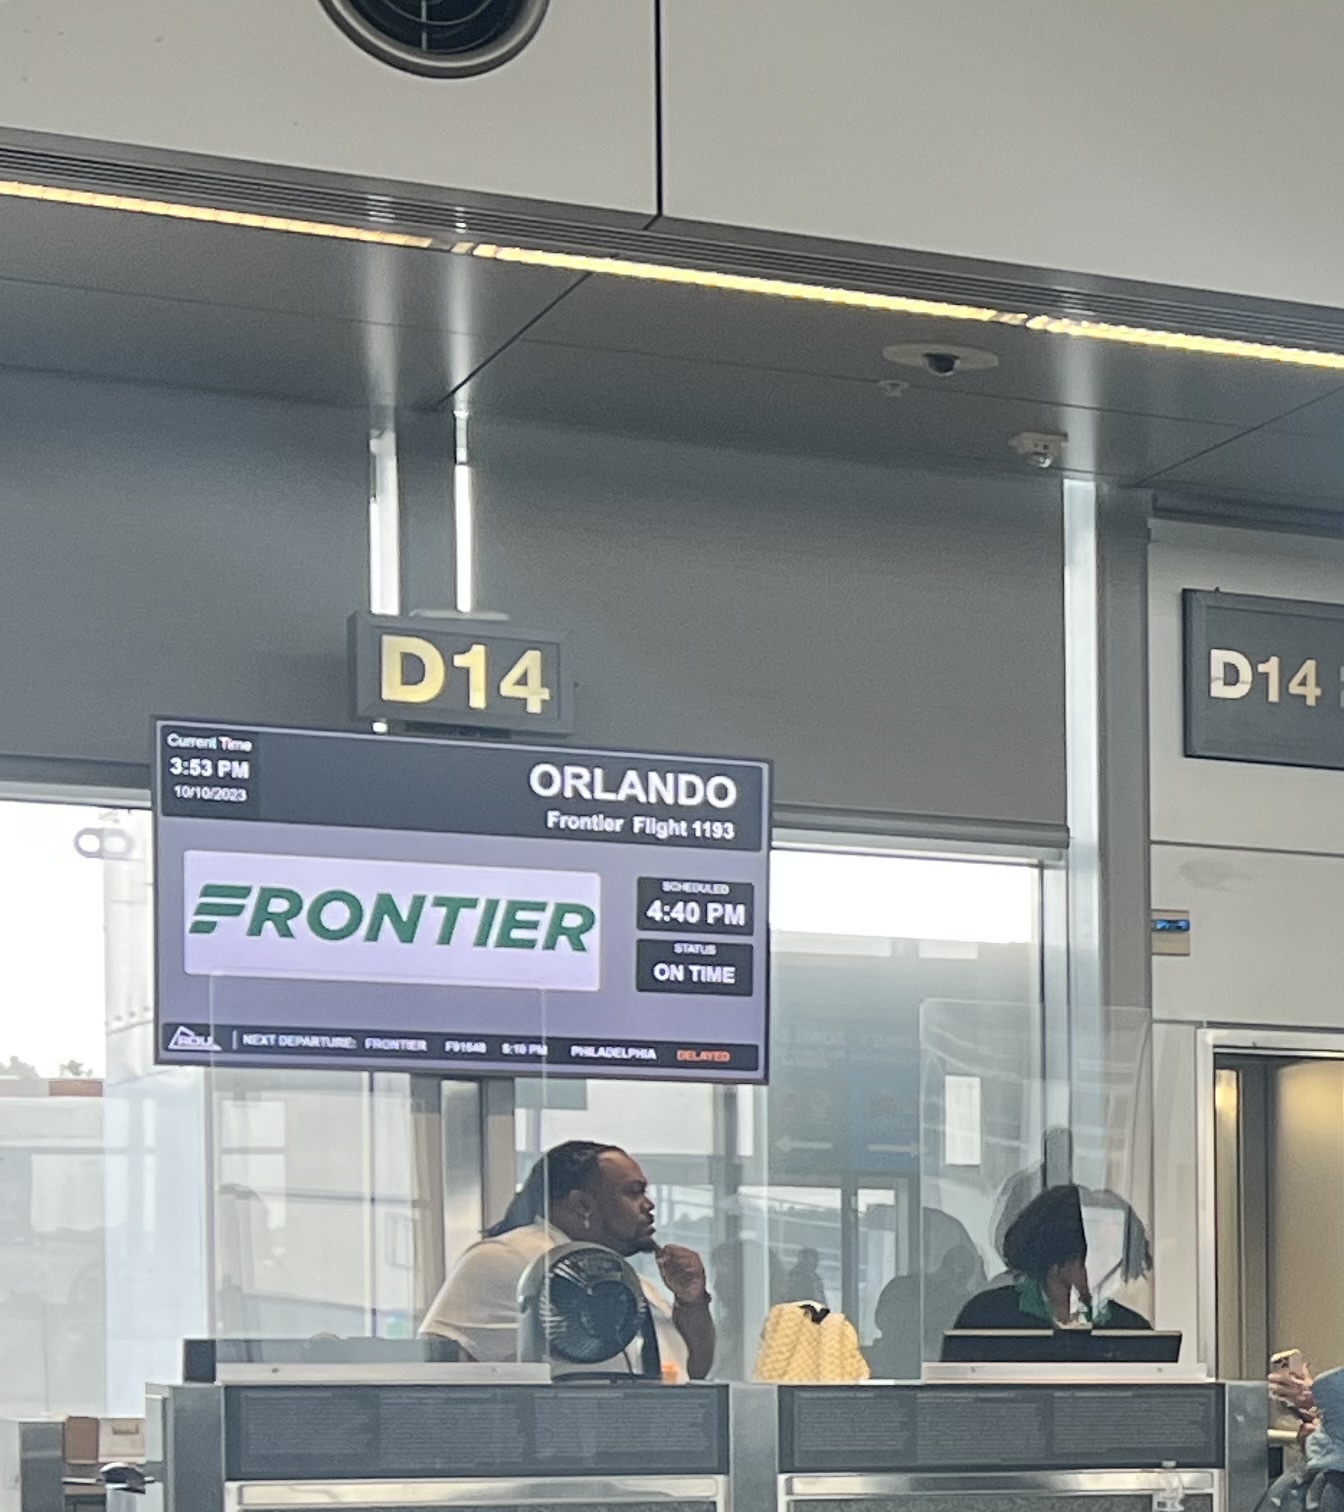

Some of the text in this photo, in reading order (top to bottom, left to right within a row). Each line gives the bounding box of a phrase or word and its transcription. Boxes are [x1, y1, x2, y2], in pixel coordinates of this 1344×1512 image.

[381, 634, 550, 714] D14
[1209, 648, 1321, 707] D14
[167, 733, 252, 752] Current Time
[169, 757, 250, 779] 3:53 PM
[174, 785, 247, 802] 10/10/2023
[530, 763, 738, 809] ORLANDO
[547, 810, 735, 841] Frontier Flight 1193
[662, 881, 730, 895] SCHEDULED
[189, 883, 596, 952] FRONTIER
[646, 900, 746, 926] 4:40 PM
[673, 942, 717, 955] STATUS
[653, 963, 736, 984] ON TIME
[243, 1034, 276, 1047] NEXT
[278, 1035, 357, 1049] DEPARTURE:
[364, 1038, 428, 1051] FRONTIER
[528, 1043, 548, 1056] PM
[570, 1045, 658, 1061] PHILADELPHIA
[676, 1049, 731, 1063] DELAYED
